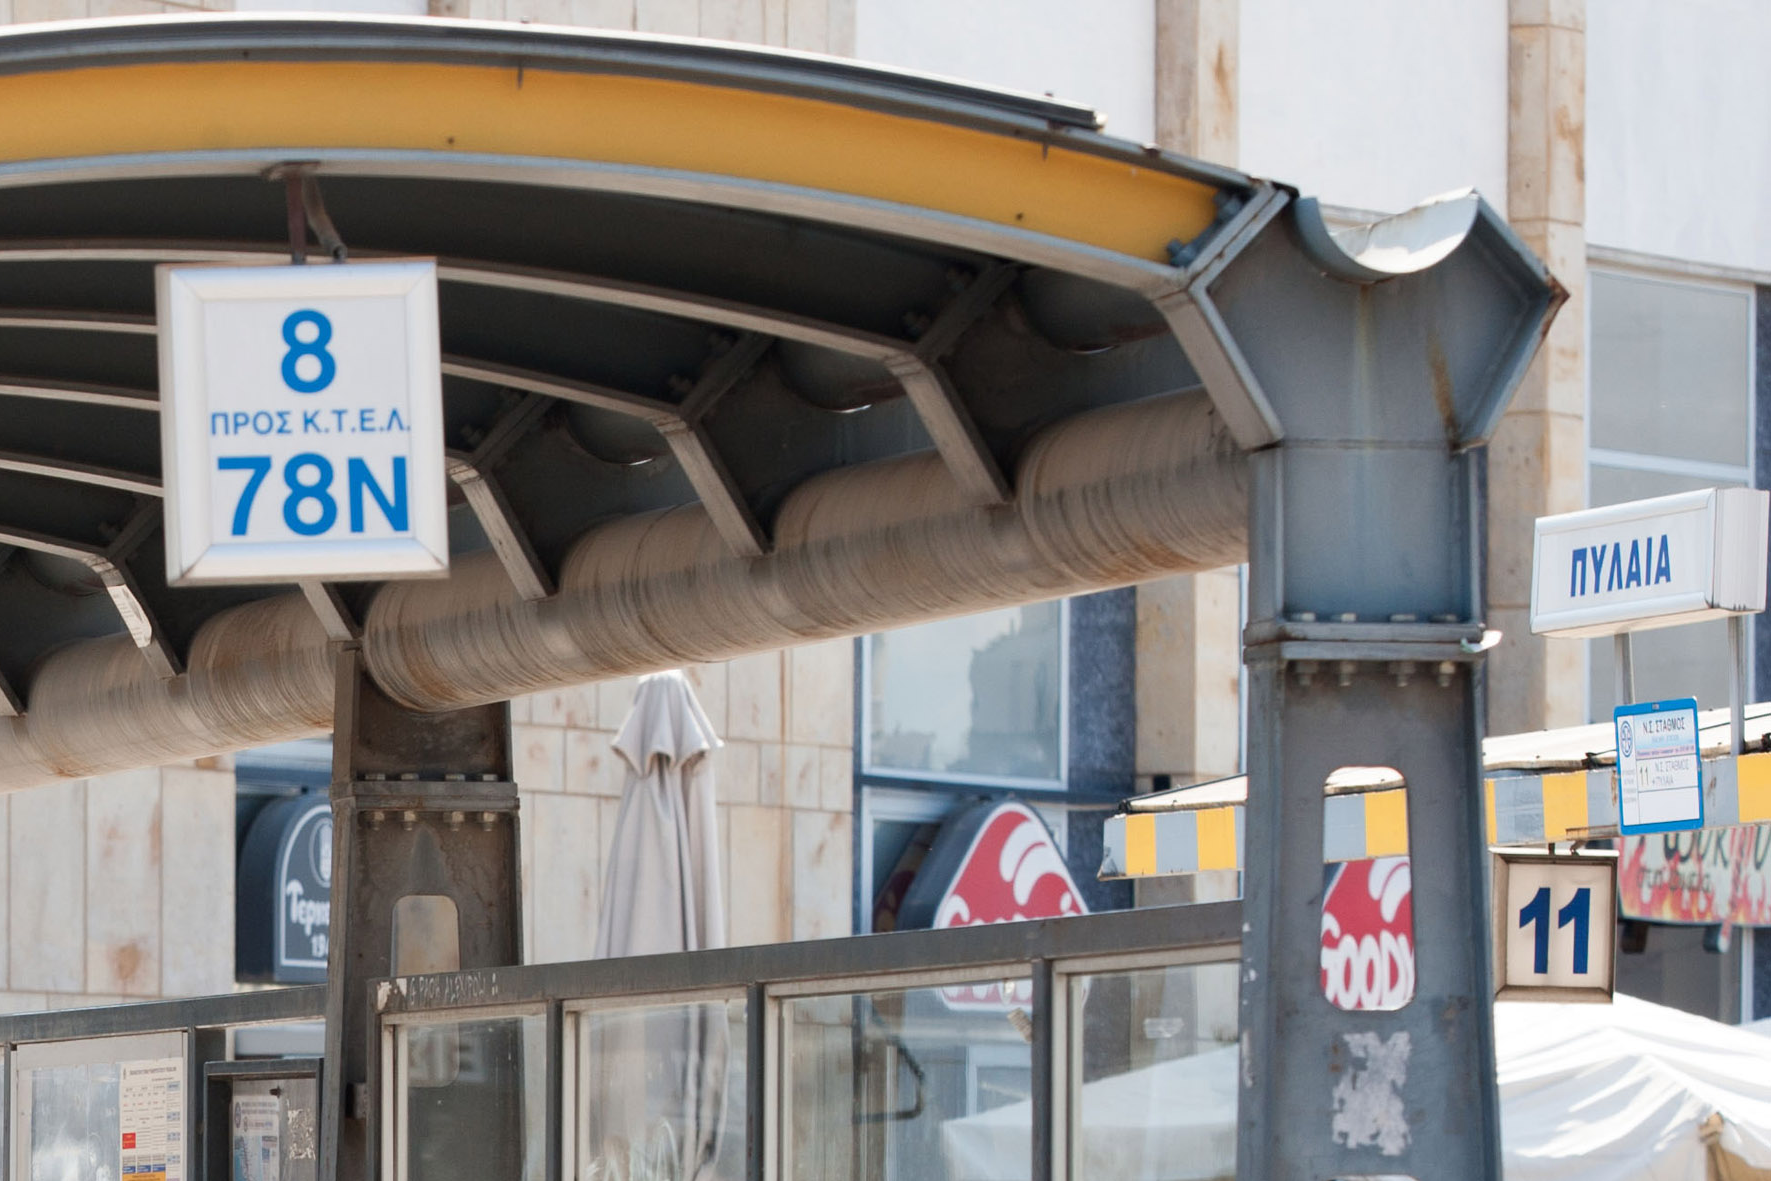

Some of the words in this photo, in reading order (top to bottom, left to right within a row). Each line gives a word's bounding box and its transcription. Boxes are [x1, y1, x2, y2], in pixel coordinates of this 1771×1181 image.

[281, 308, 336, 394] 8
[211, 411, 292, 435] ΠΡΟΣ
[303, 408, 411, 433] Κ.Τ.Ε.Λ.
[217, 453, 409, 536] 78N
[1570, 534, 1671, 597] ΠΥΛΑΙΑ
[1519, 887, 1590, 974] 11
